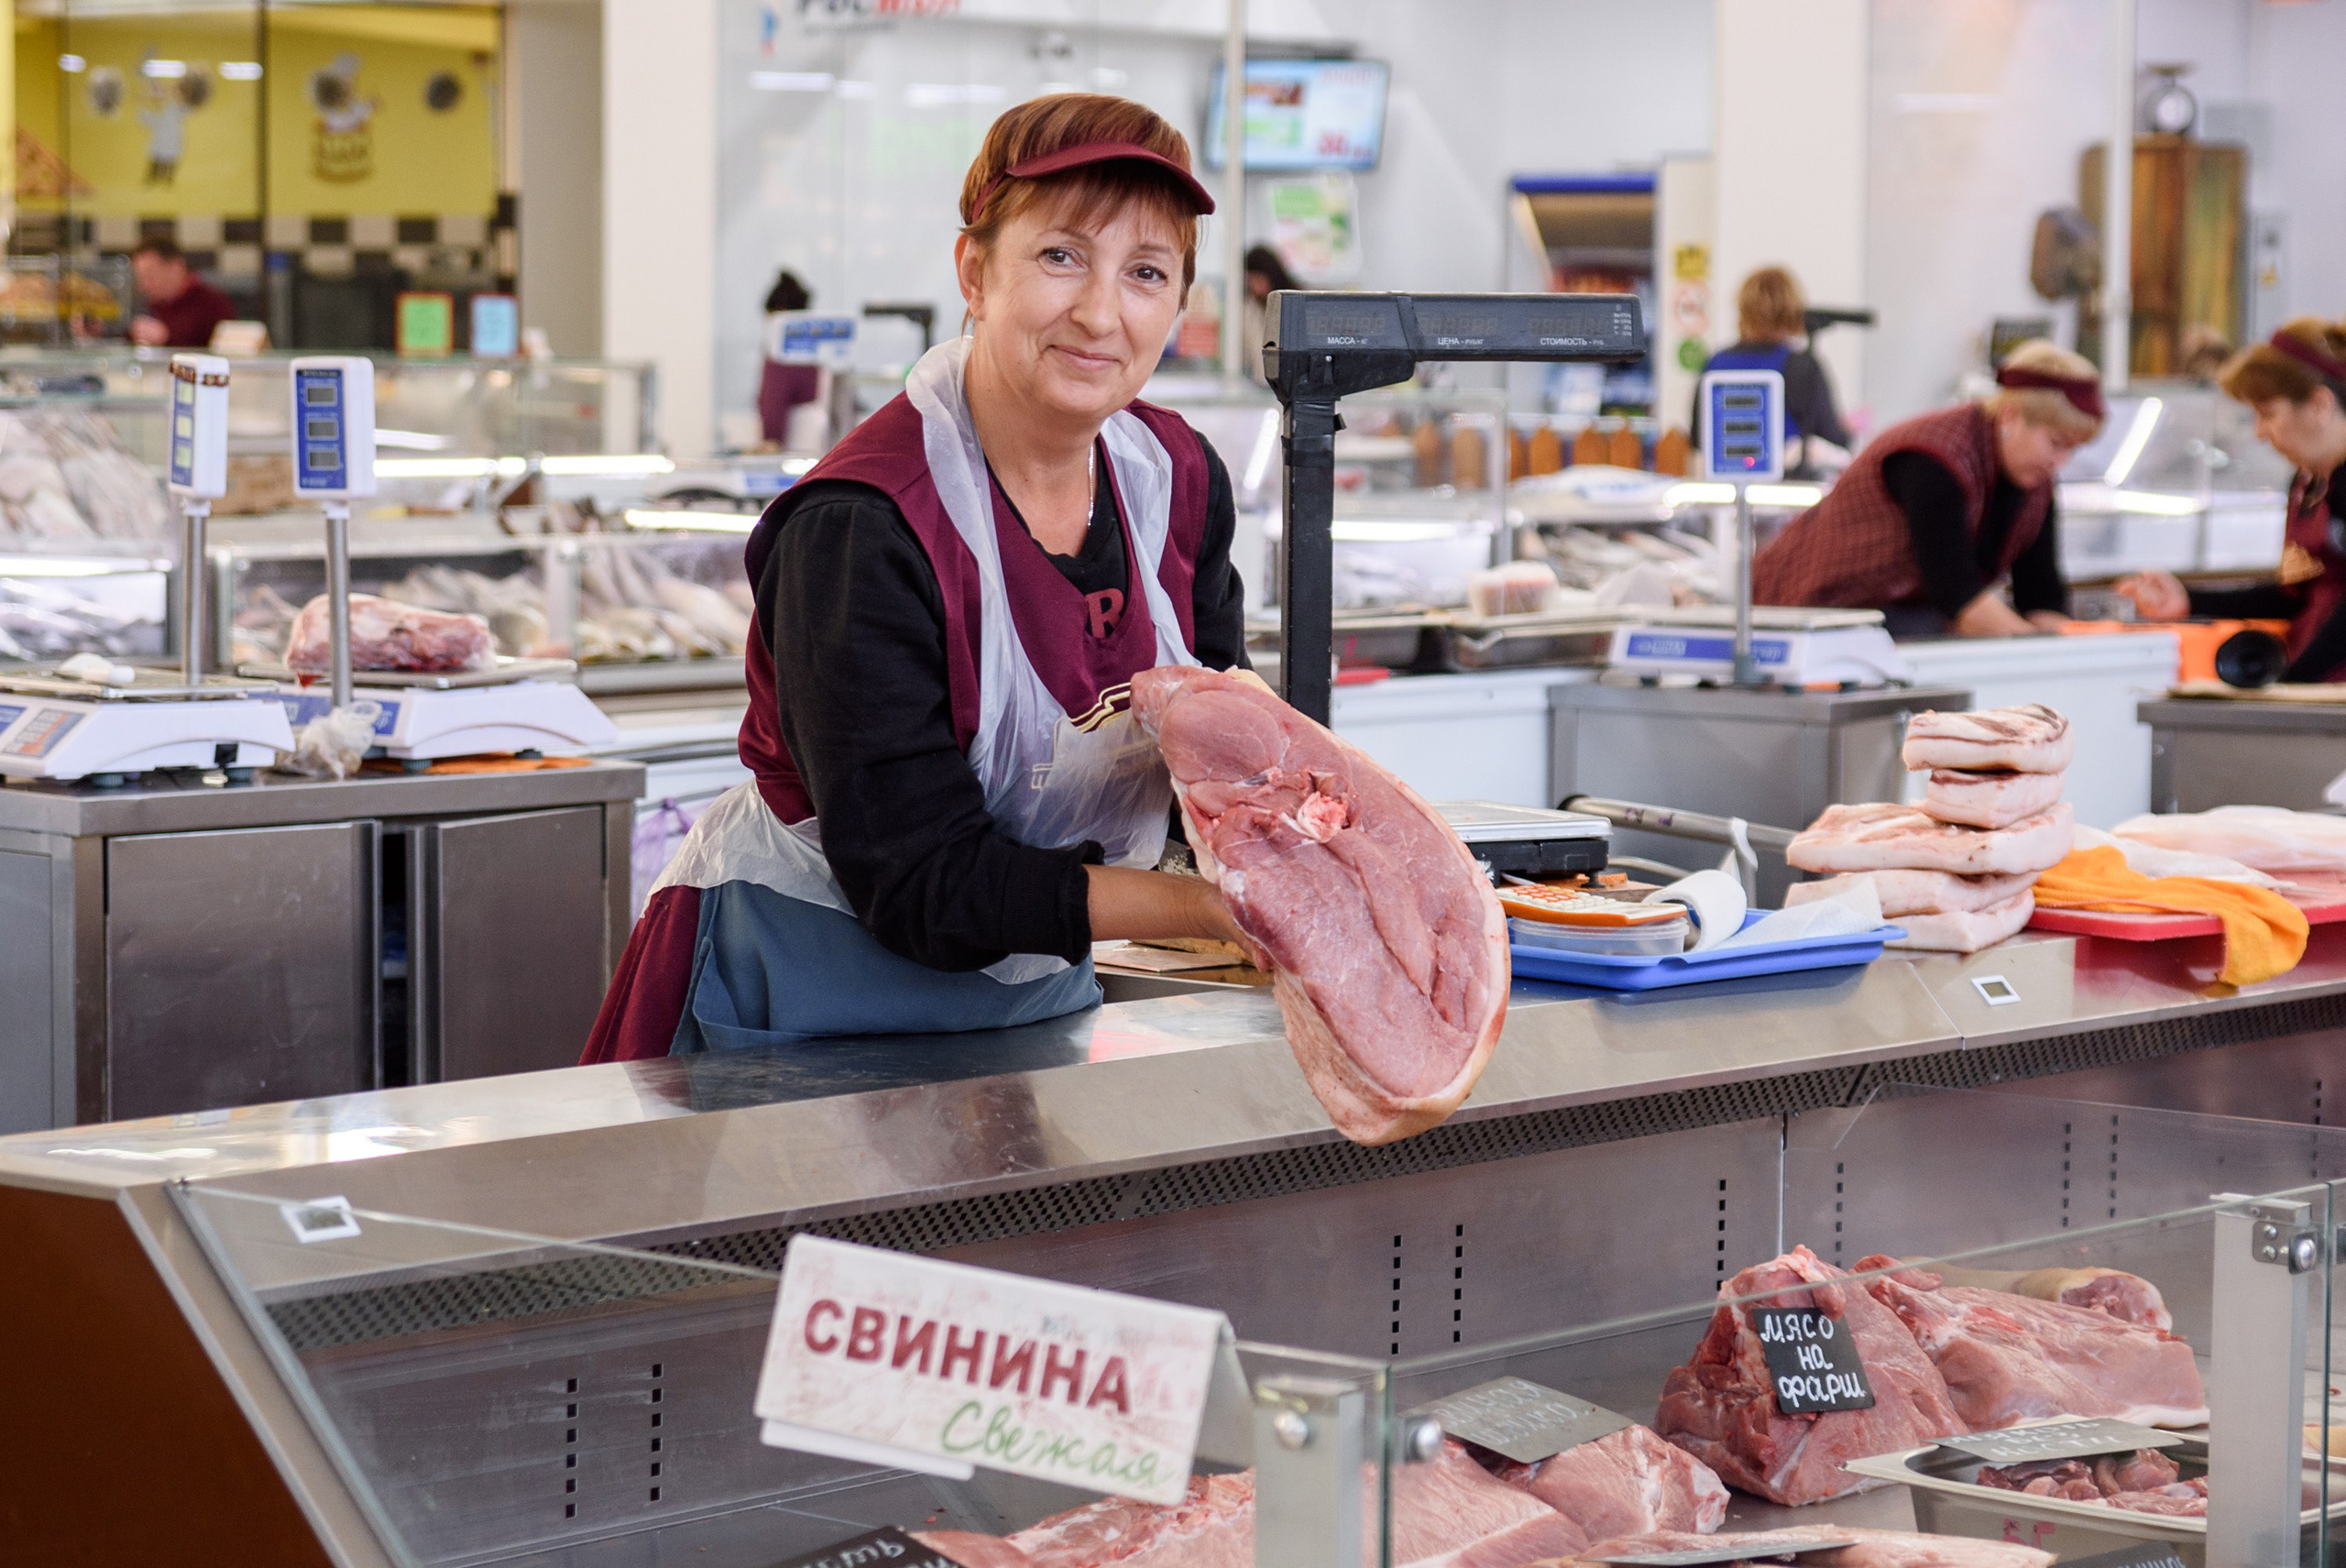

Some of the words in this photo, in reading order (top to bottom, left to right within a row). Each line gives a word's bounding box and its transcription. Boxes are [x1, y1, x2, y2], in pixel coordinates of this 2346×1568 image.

[1327, 336, 1355, 345] МАССА
[1437, 337, 1460, 345] ЦЕНА
[1540, 337, 1587, 346] СТОИМОСТЬ
[804, 1298, 1132, 1415] СВИНИНА
[940, 1400, 1170, 1488] Свежая
